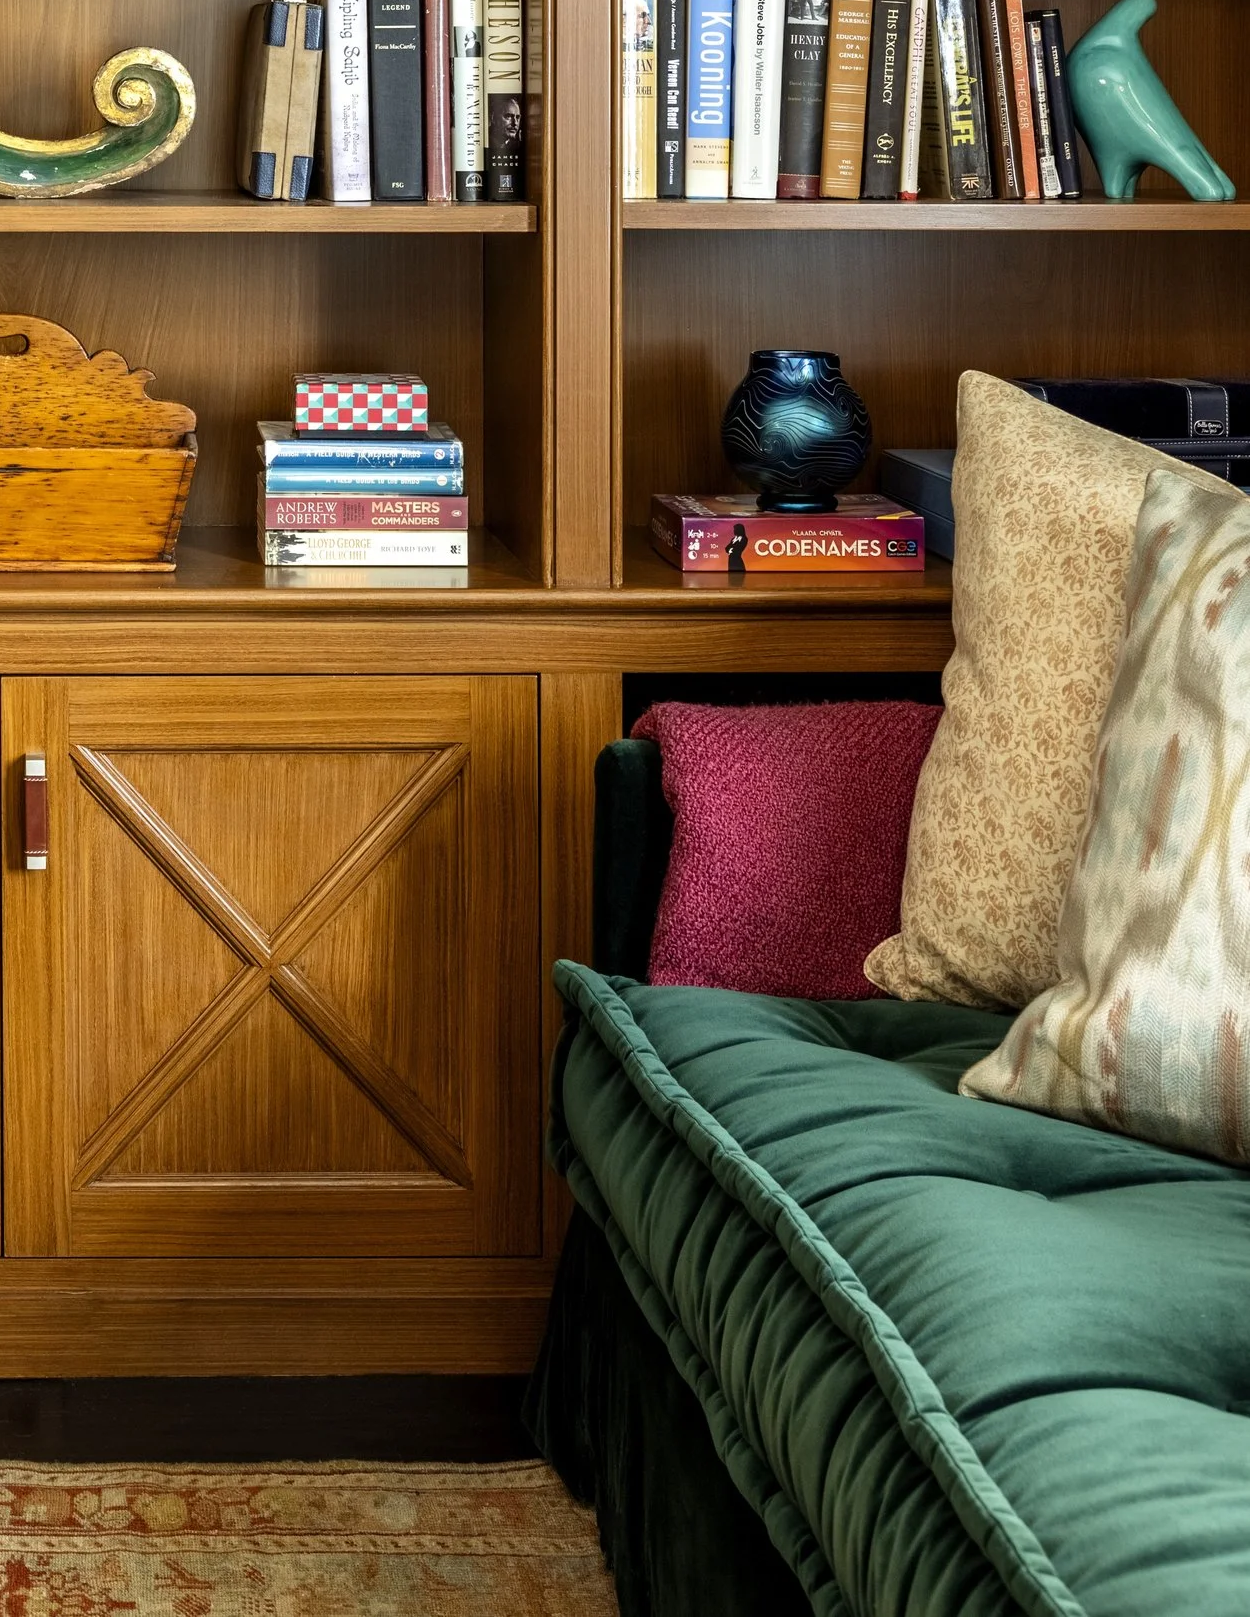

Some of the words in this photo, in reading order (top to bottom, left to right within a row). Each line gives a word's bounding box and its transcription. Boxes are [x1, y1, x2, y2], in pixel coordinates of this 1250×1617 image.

[888, 8, 899, 30] HIS
[757, 25, 765, 46] Jobs
[791, 35, 826, 46] HENRY
[912, 7, 925, 62] GANDHI
[755, 49, 764, 59] by
[794, 50, 821, 61] CLAY
[691, 12, 733, 125] Kooning
[756, 60, 764, 88] Walter
[882, 32, 898, 106] EXCELLENCY
[910, 66, 919, 101] GREAT
[754, 91, 763, 136] Isaacson
[908, 104, 917, 132] SOUL
[950, 110, 974, 146] LIFE
[276, 503, 337, 512] ANDREW
[372, 502, 440, 513] MASTERS
[277, 514, 337, 524] ROBERTS
[371, 517, 439, 525] COMMANDERS
[754, 539, 880, 557] CODENAMES
